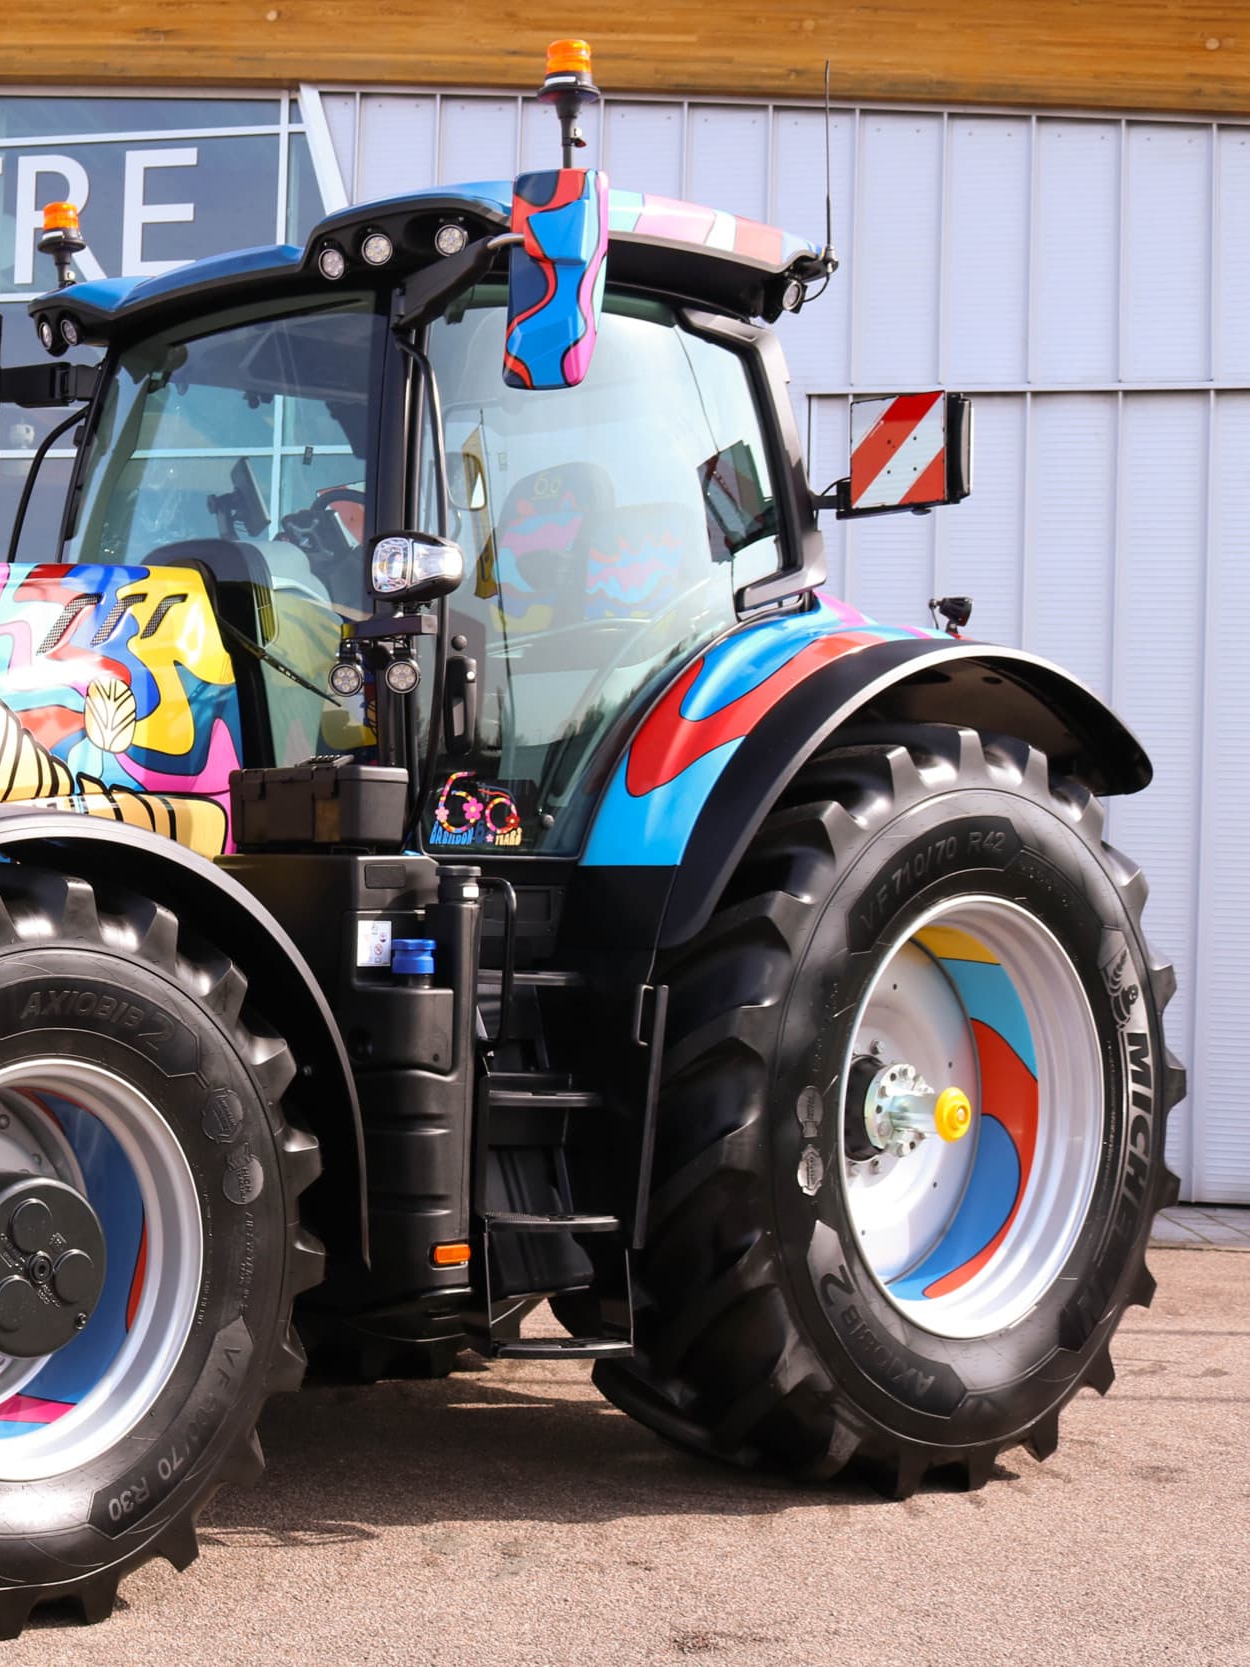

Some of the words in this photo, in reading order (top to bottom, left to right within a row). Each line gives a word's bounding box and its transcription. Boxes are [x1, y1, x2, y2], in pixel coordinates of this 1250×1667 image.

[967, 831, 1006, 855] R42
[20, 990, 144, 1027] AXIOBIB
[820, 1263, 856, 1307] 2
[108, 1476, 150, 1521] R30
